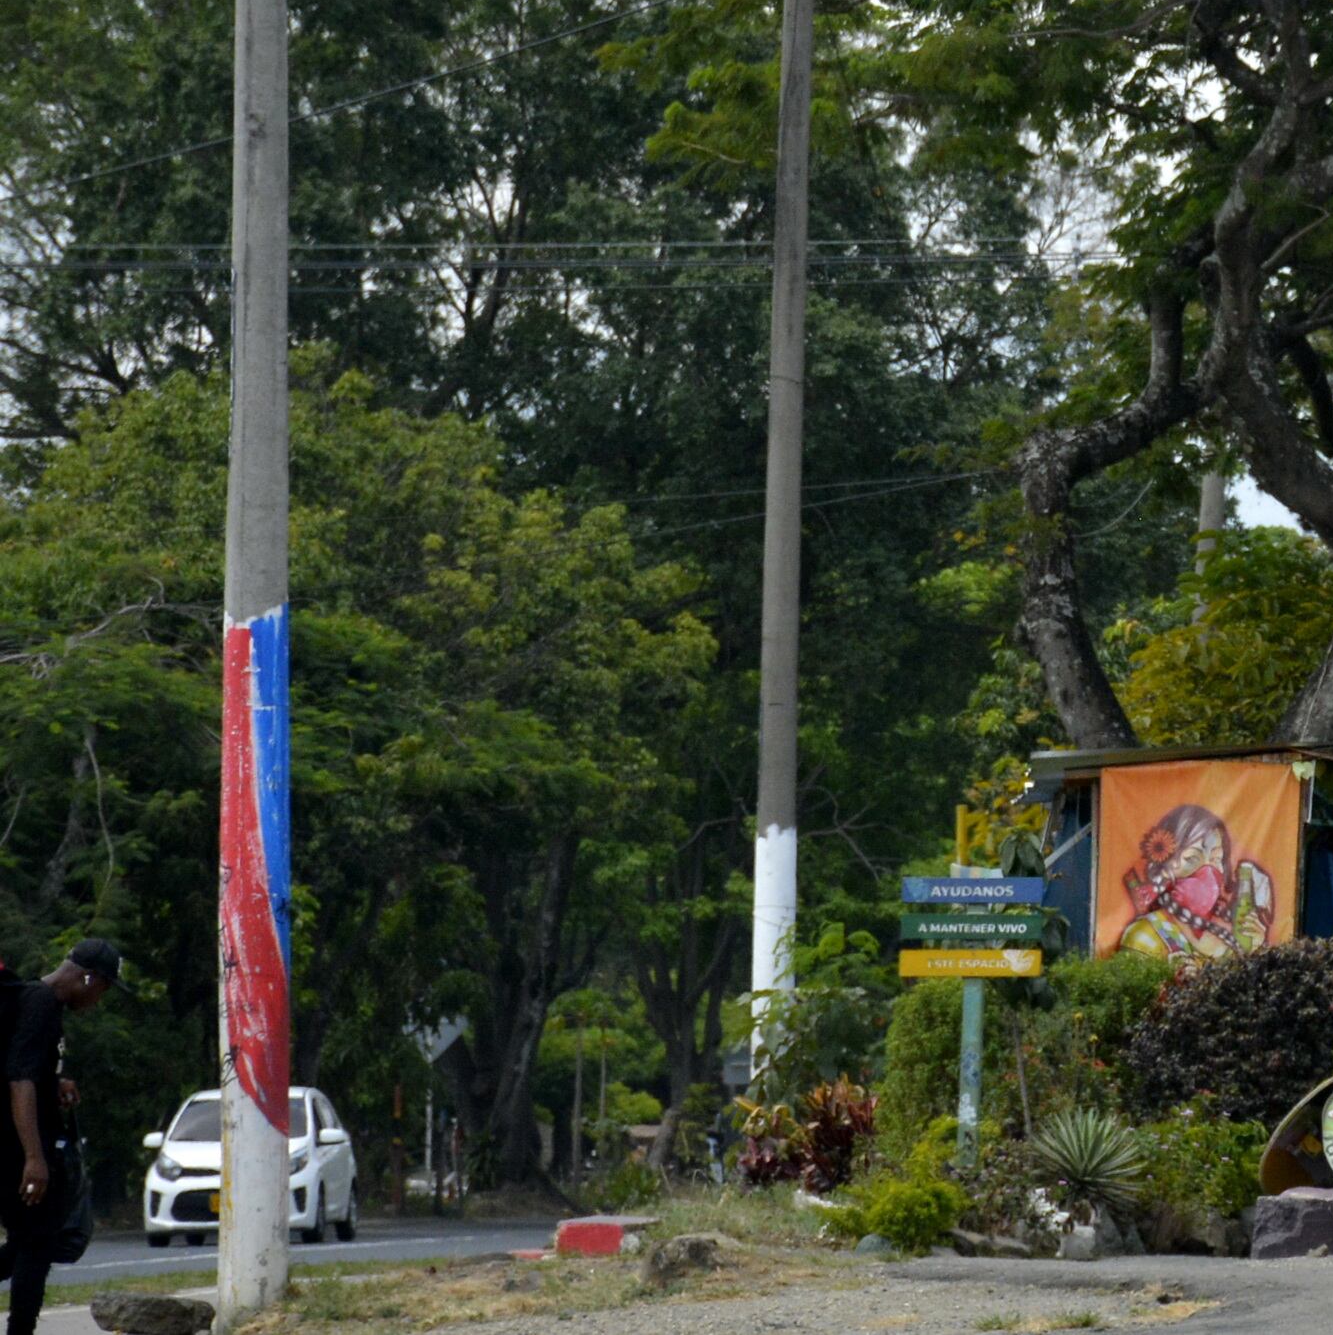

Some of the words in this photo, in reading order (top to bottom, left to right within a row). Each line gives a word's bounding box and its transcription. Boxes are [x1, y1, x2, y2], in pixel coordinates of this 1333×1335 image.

[930, 885, 1014, 897] AYUDANOS
[918, 924, 927, 933] A
[930, 923, 996, 933] MANTENER
[999, 923, 1027, 933] VIVO
[927, 958, 954, 969] ESTE
[959, 958, 1009, 969] ESPACIO
